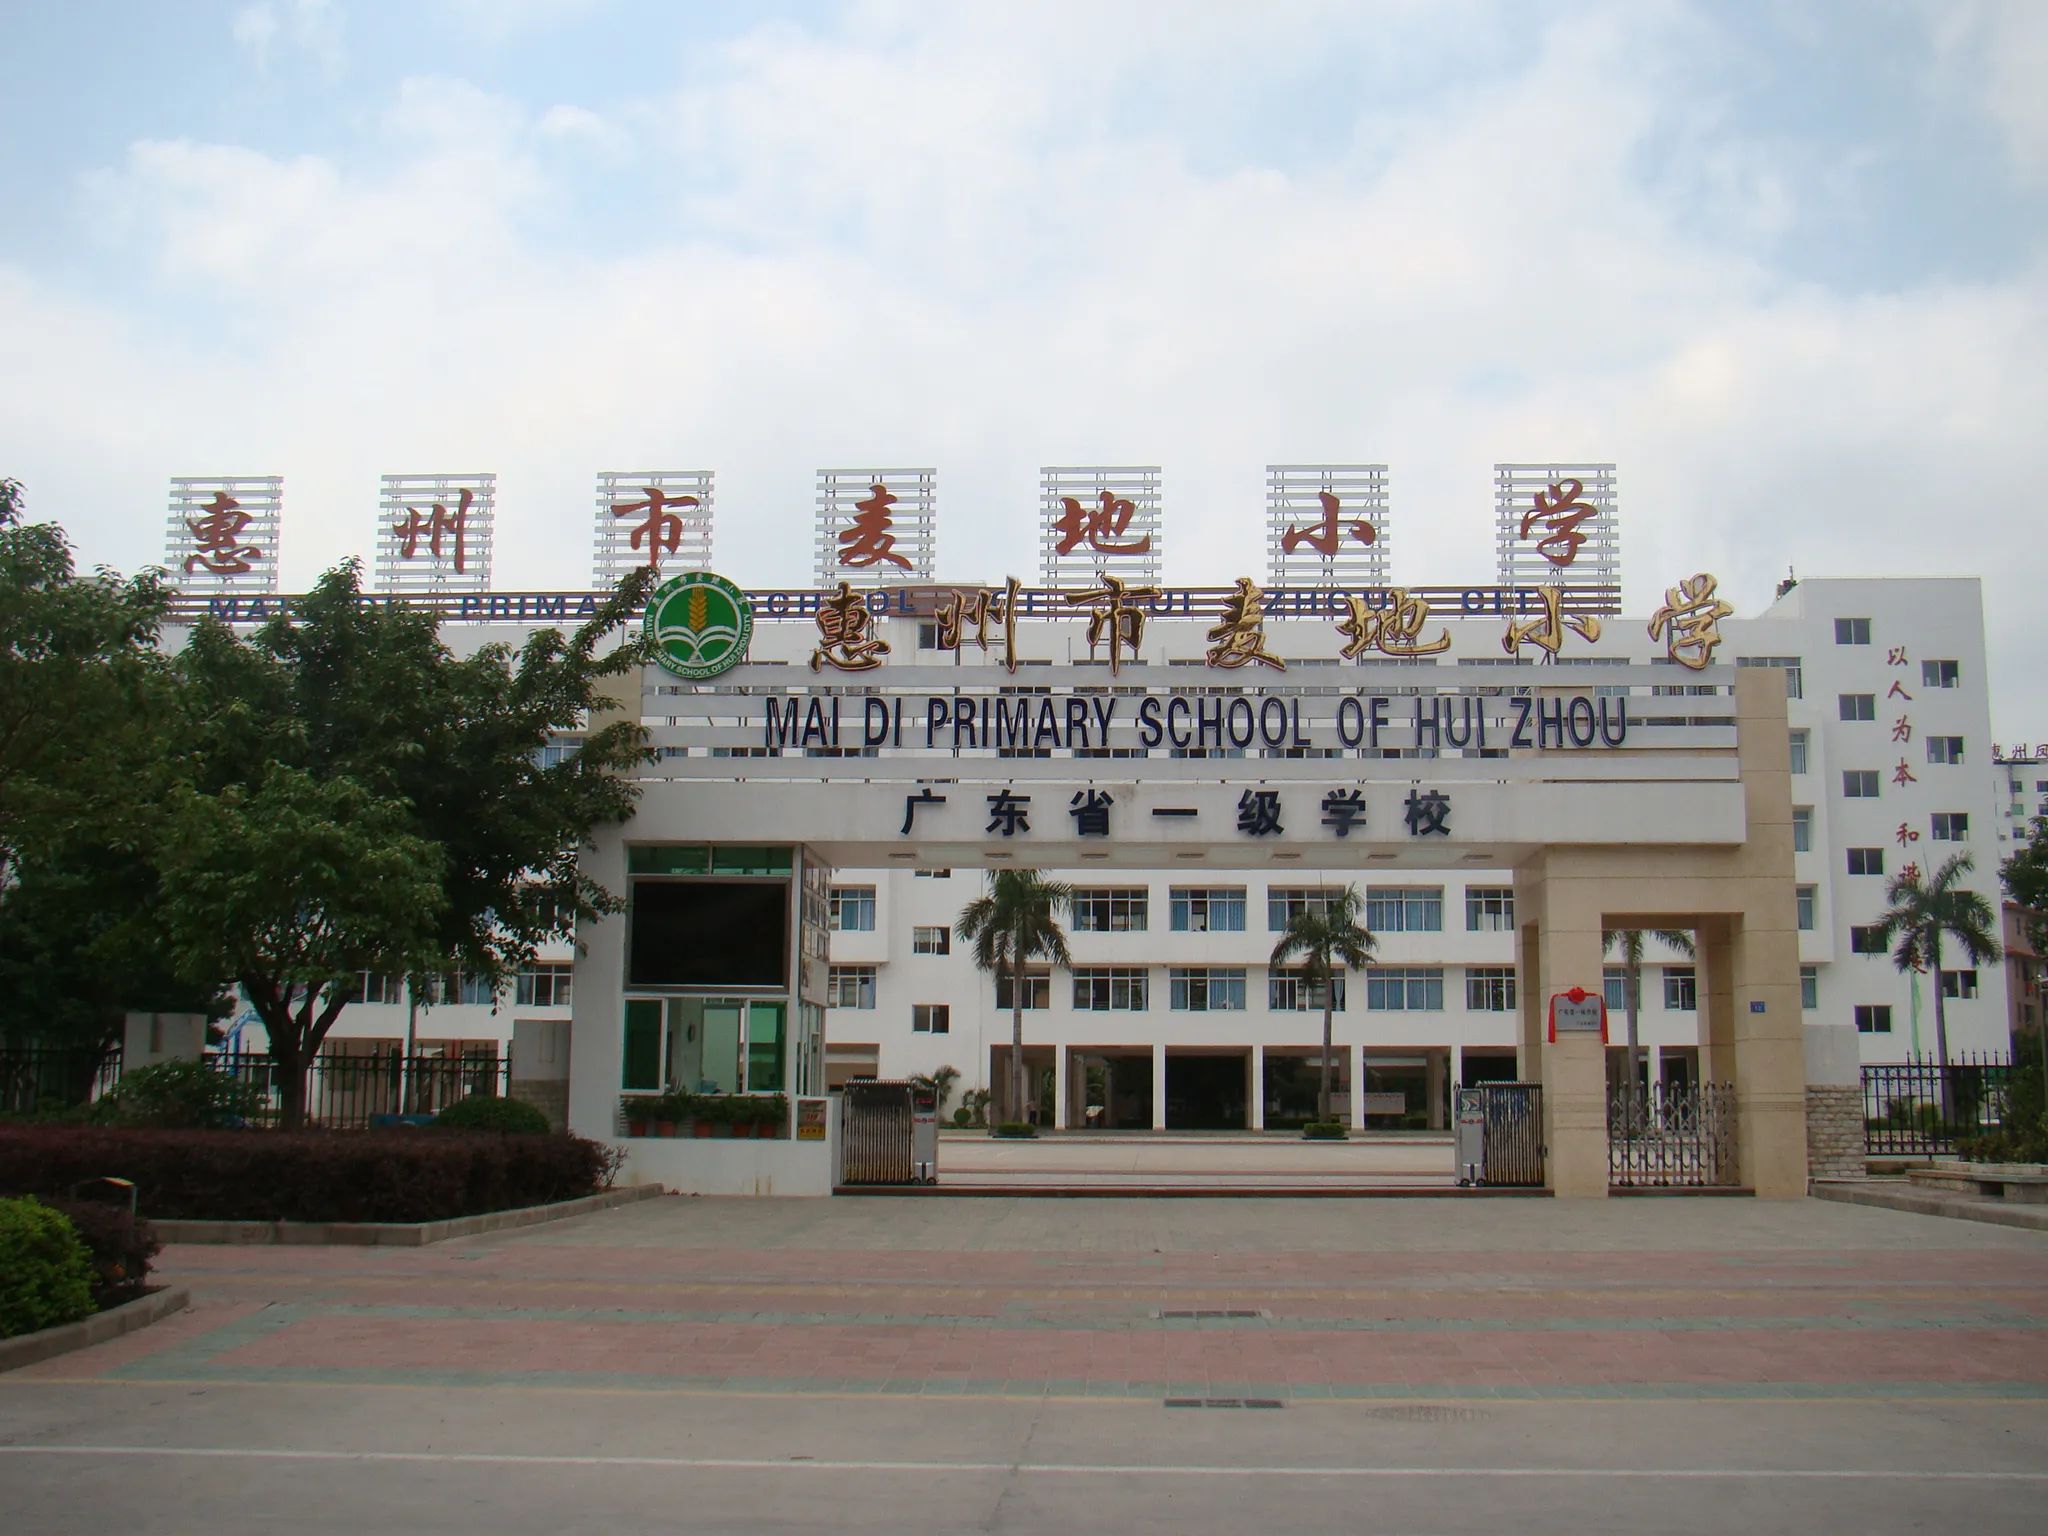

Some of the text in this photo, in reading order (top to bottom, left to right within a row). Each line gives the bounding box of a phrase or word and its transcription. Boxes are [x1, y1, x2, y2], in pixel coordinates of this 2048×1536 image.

[184, 478, 1598, 574] 惠州市麦地小学
[744, 589, 916, 616] SCHOL
[808, 573, 1733, 676] 惠州市麦地小学
[646, 614, 655, 631] MAI
[676, 665, 710, 676] SCHOOL
[711, 663, 723, 672] OF
[722, 653, 737, 667] HUI
[734, 633, 749, 656] ZHOU
[743, 613, 751, 632] CITY
[766, 696, 1628, 749] MAI DI PRIMARY SCHOOL OF HUI ZHOU
[1887, 646, 1918, 788] 以人为本
[900, 788, 1451, 837] 广东省一级学校
